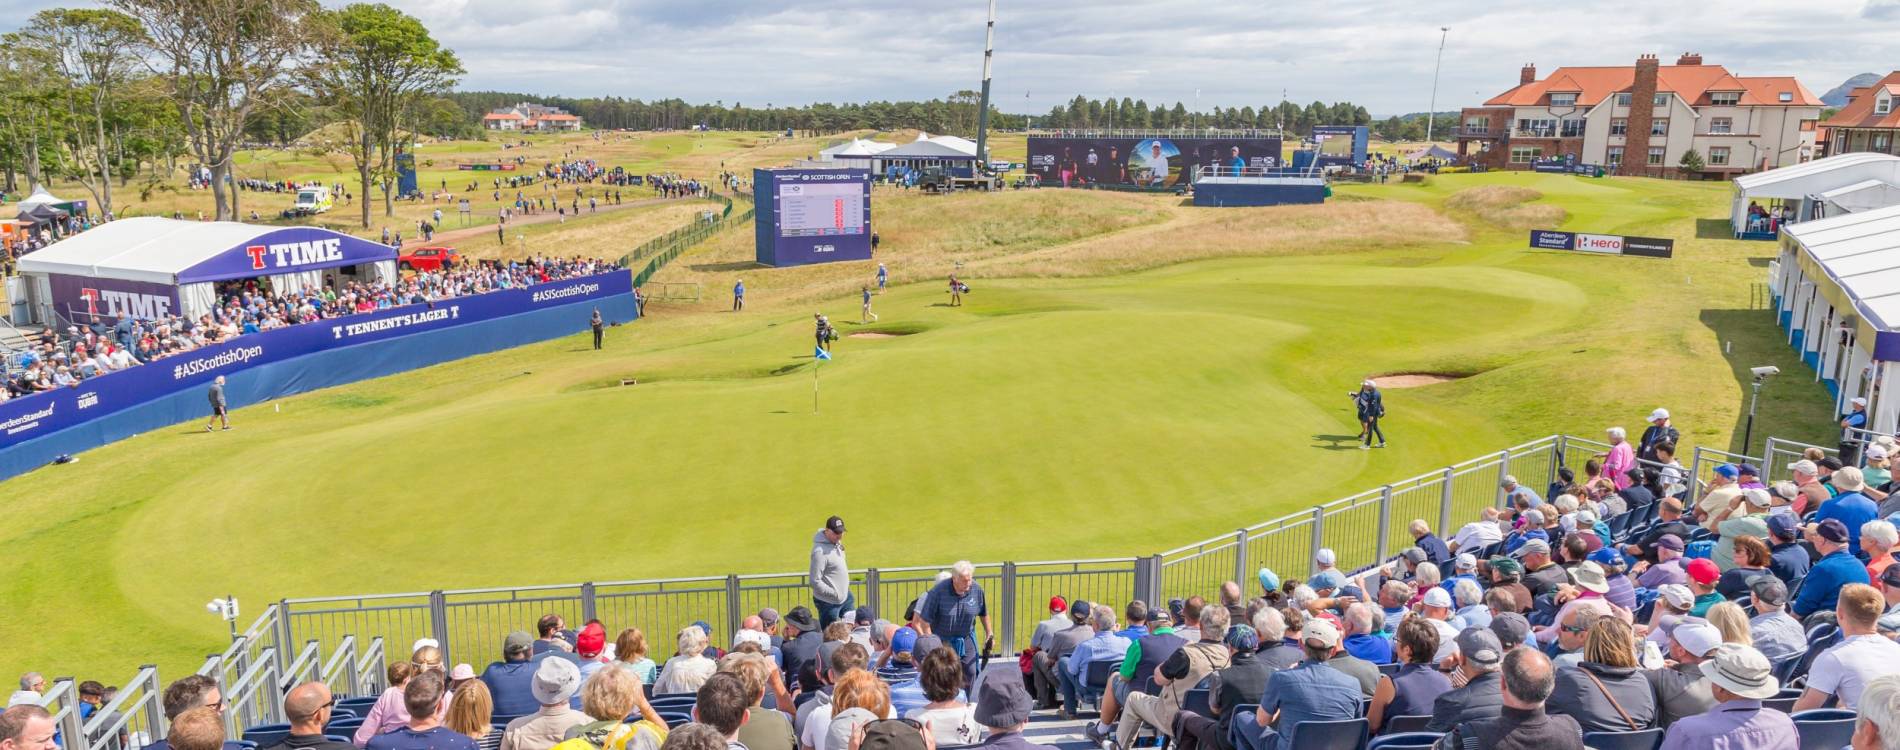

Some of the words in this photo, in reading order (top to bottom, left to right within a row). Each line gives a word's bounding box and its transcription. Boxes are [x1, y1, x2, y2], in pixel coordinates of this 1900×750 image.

[246, 245, 267, 270] T
[269, 238, 343, 268] TIME
[101, 289, 171, 322] TIME
[532, 283, 599, 303] #ASIScottishOpen
[332, 325, 343, 339] T
[346, 315, 411, 337] TENNENT'S
[412, 309, 448, 325] LAGER
[173, 345, 263, 380] #ASIScottishOpen
